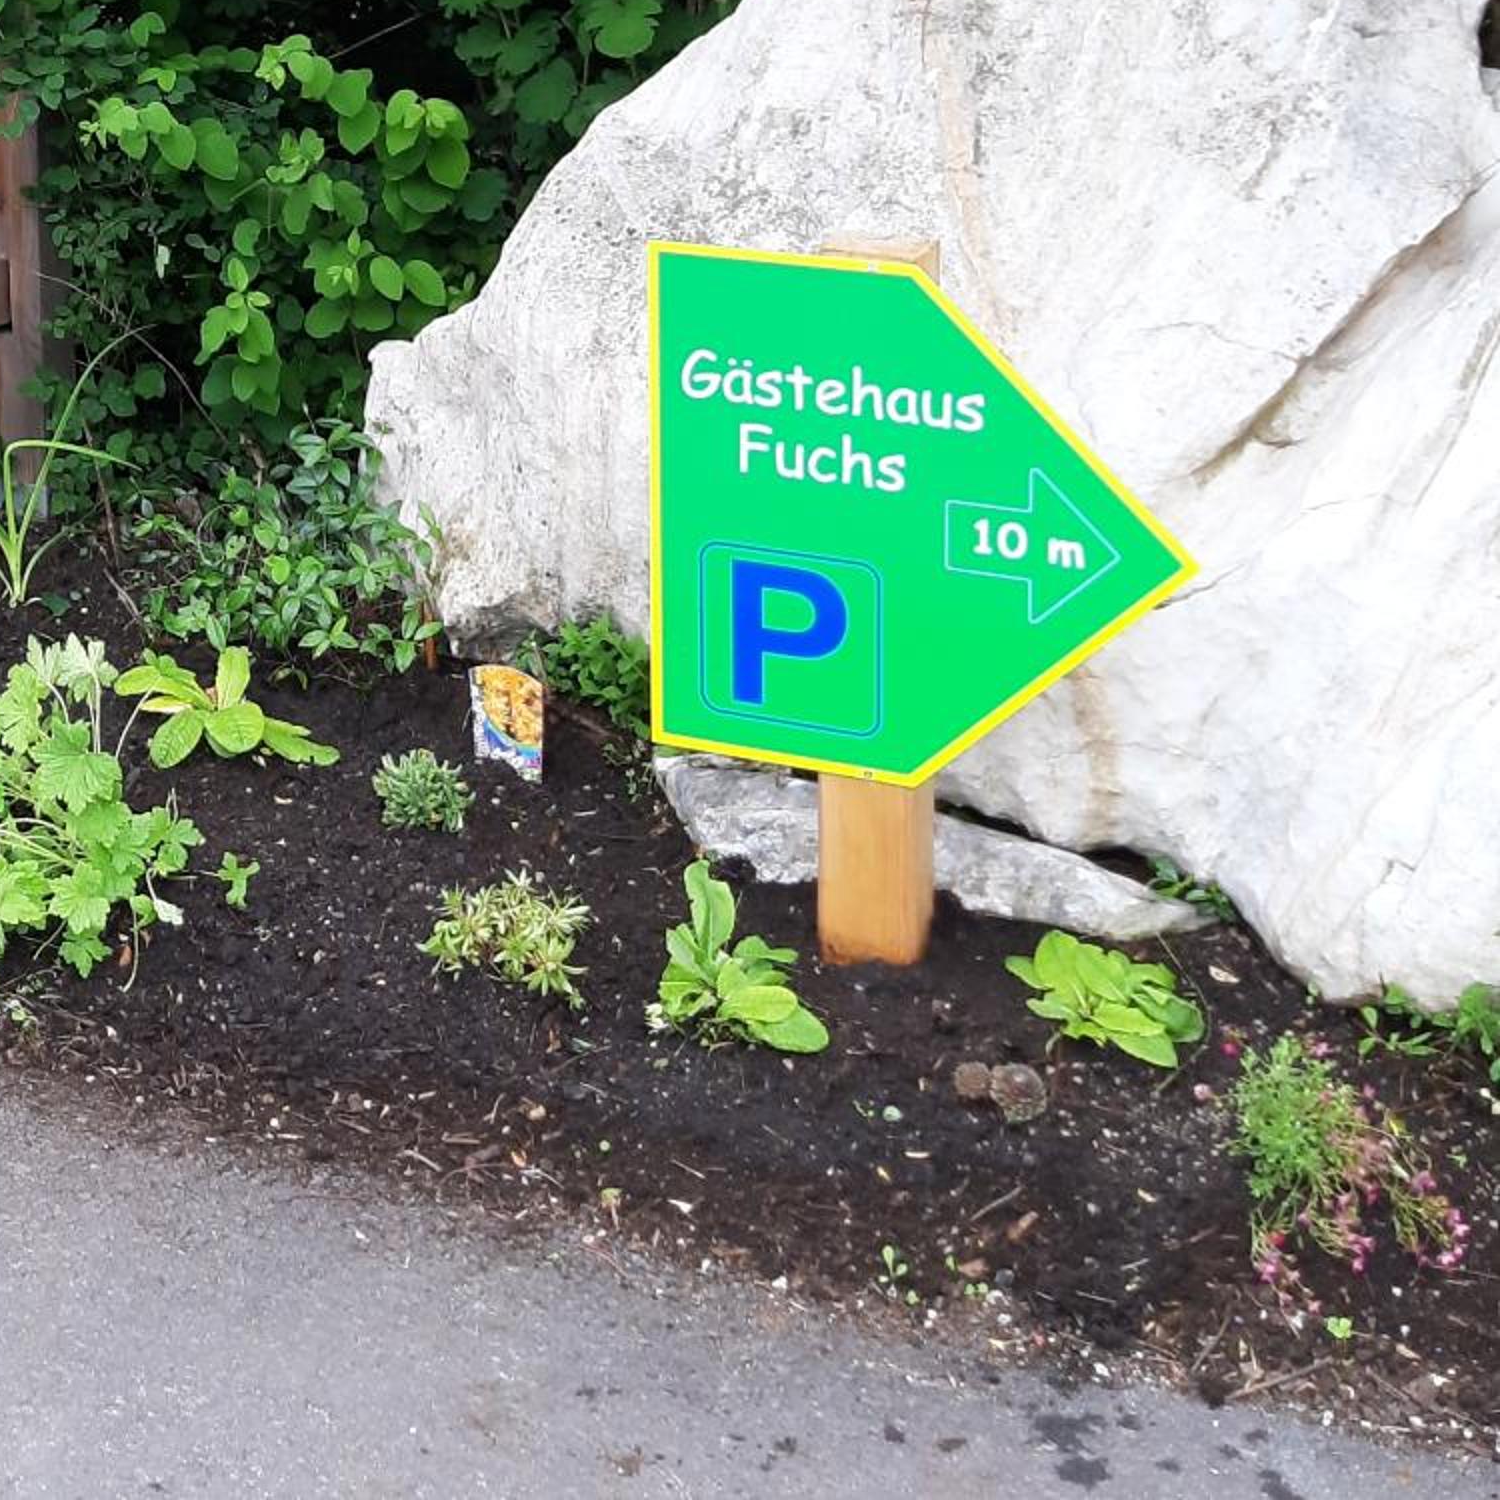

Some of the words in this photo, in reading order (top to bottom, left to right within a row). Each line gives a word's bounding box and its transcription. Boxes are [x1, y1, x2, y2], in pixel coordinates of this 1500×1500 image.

[680, 349, 986, 433] Gästehaus
[738, 423, 907, 493] Fuchs
[972, 518, 1028, 560] 10
[1047, 535, 1086, 569] m
[731, 558, 848, 705] P
